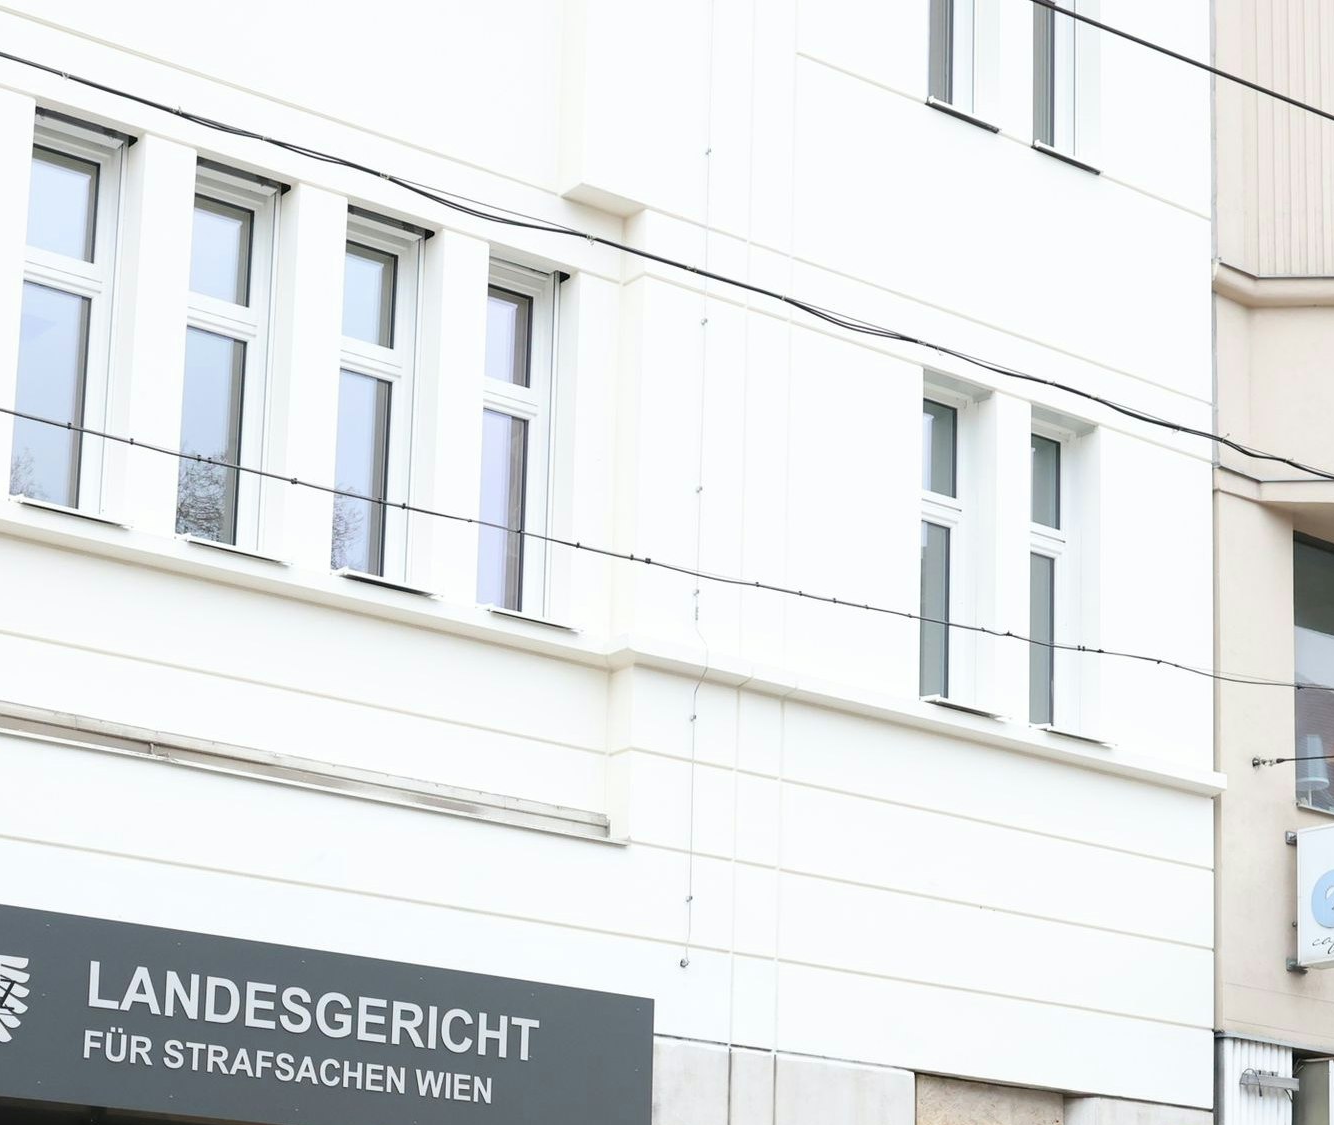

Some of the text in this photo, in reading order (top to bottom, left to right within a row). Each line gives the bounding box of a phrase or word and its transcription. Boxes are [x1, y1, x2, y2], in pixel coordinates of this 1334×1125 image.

[87, 959, 540, 1062] LANDESGERICHT
[82, 1027, 493, 1105] FÜR STRAFSACHEN WIEN
